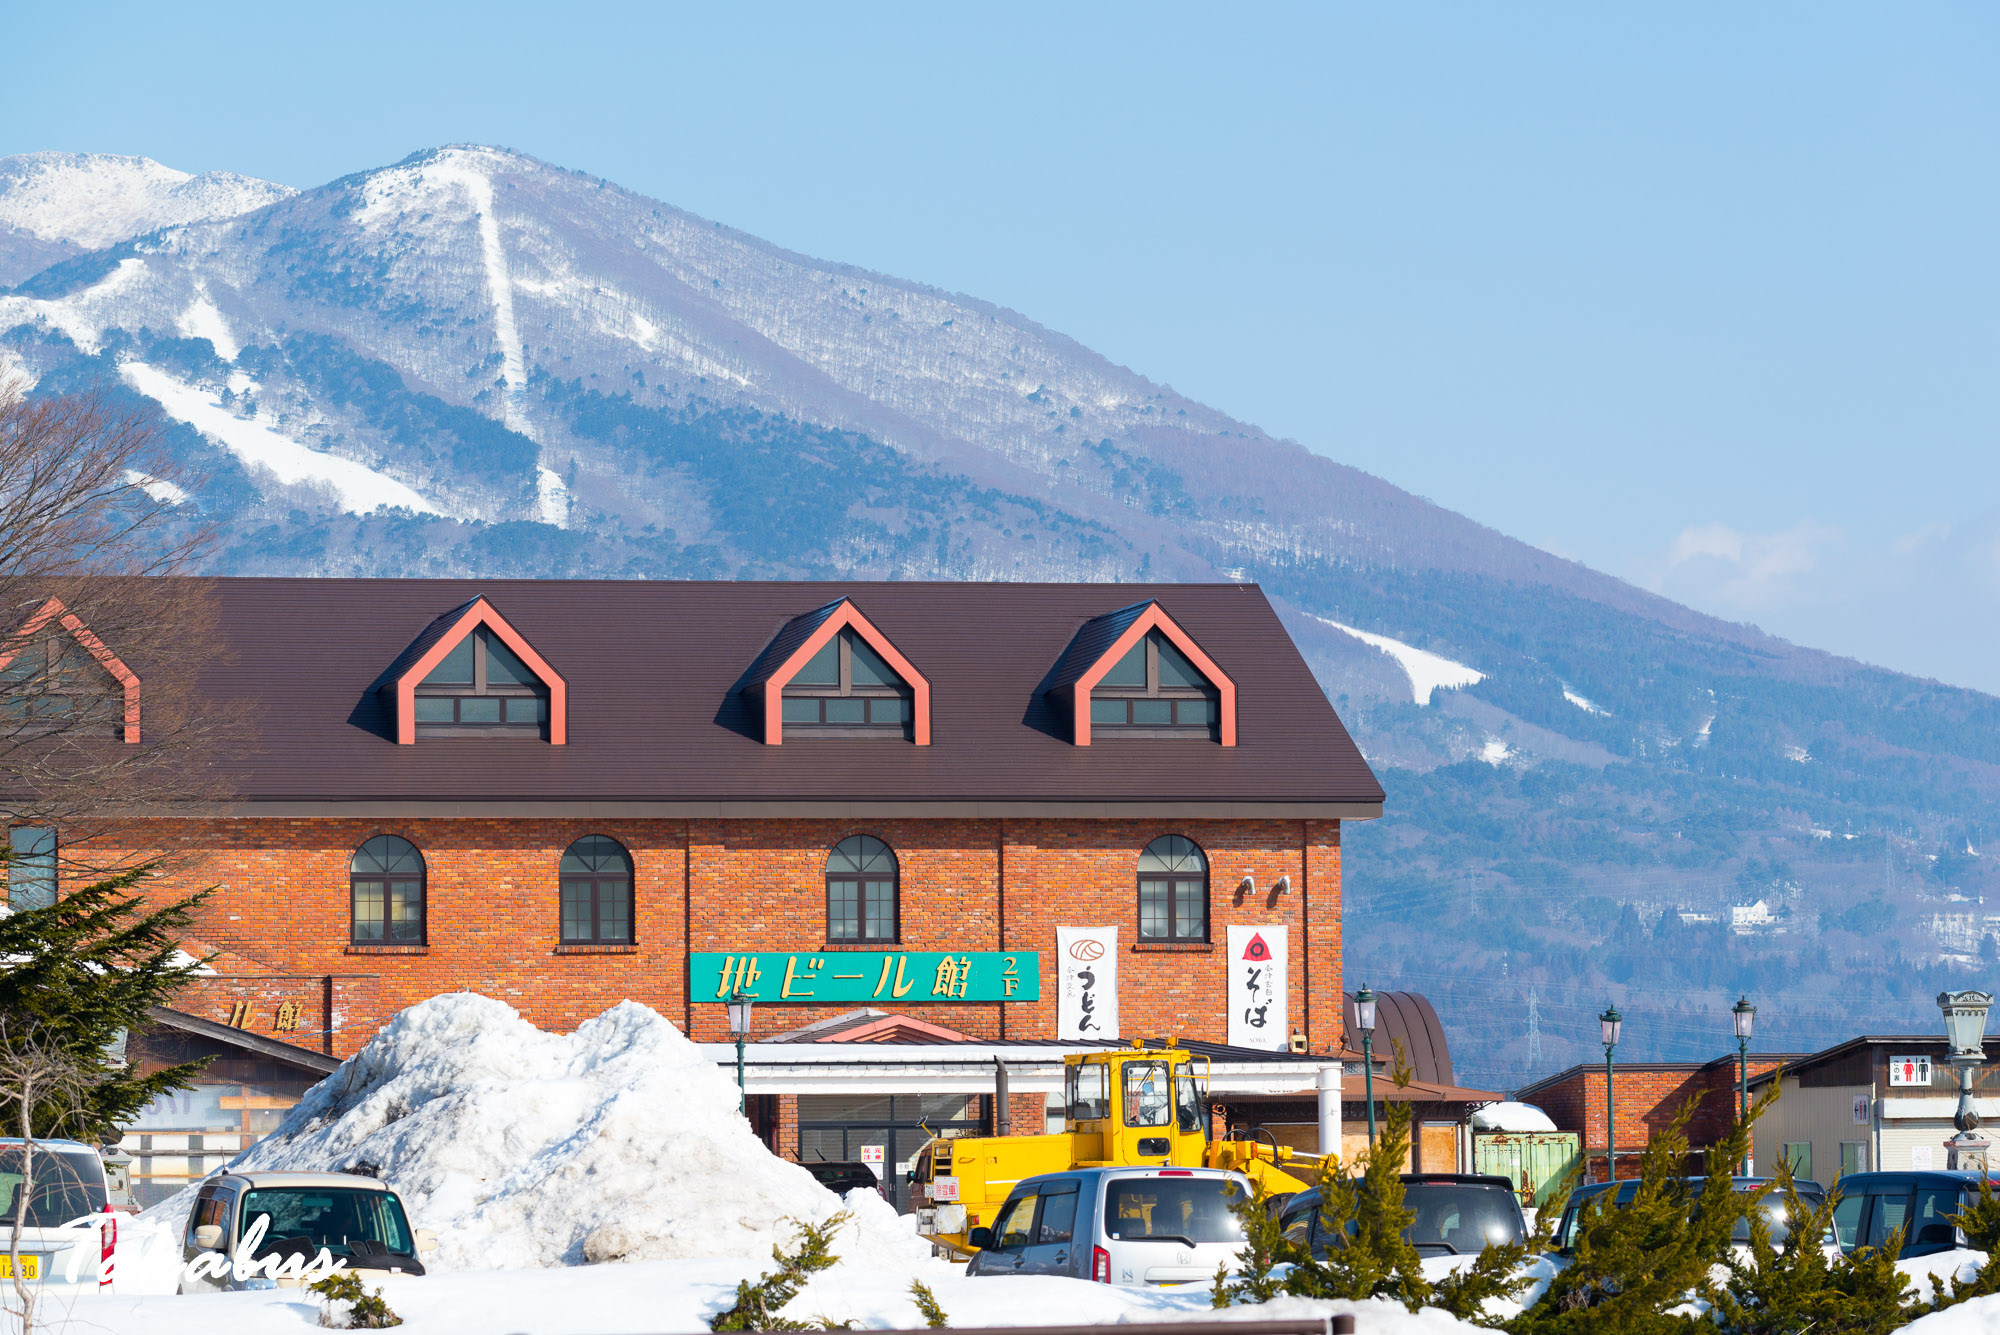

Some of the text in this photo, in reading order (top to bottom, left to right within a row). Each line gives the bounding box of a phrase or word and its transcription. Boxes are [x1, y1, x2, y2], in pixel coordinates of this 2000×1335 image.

[716, 955, 972, 999] 地ビール館
[1077, 965, 1101, 1032] うどん
[1244, 966, 1273, 1029] そば
